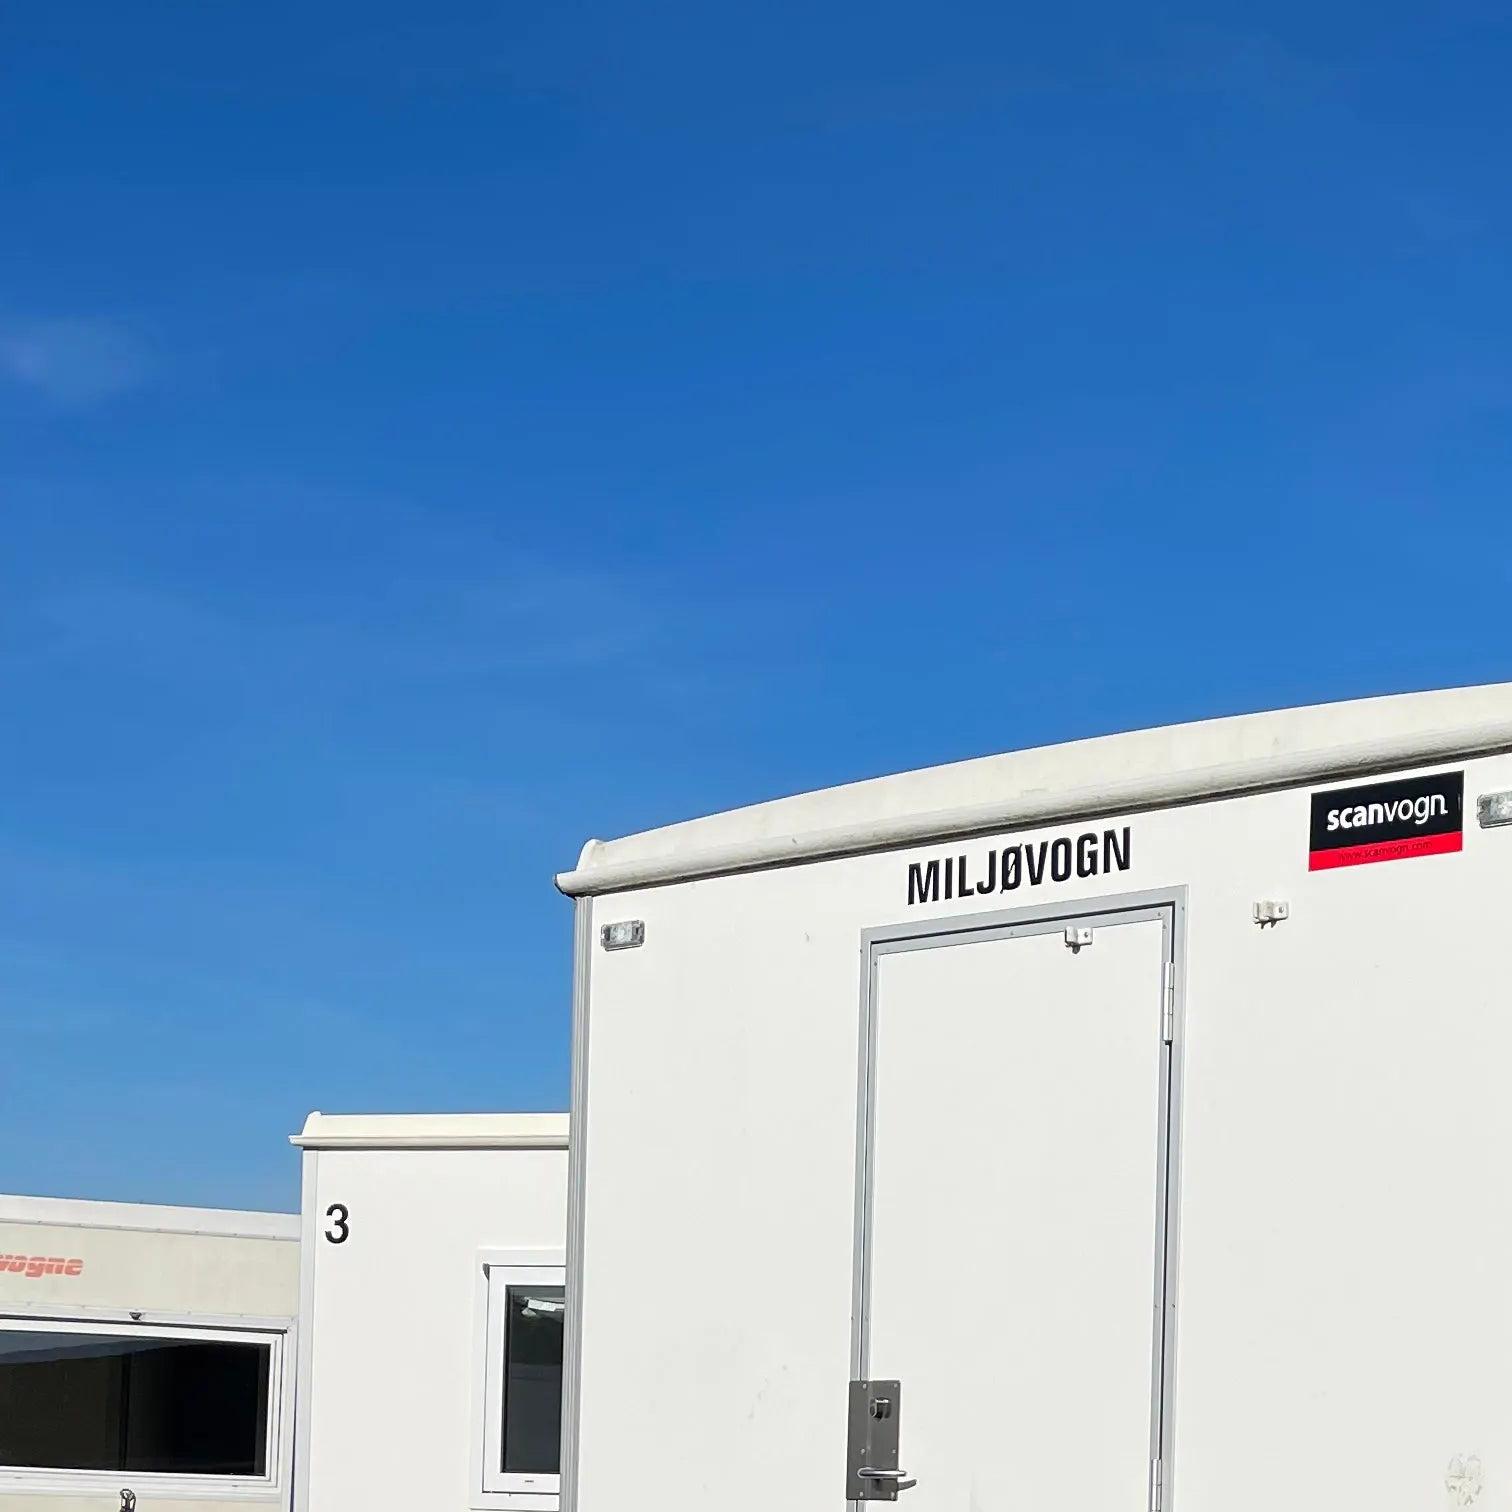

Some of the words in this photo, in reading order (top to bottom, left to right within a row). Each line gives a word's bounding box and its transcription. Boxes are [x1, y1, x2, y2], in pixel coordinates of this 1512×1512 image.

[1326, 794, 1449, 832] scanvogn
[907, 826, 1131, 905] MILJØVOGN
[324, 1203, 350, 1244] 3
